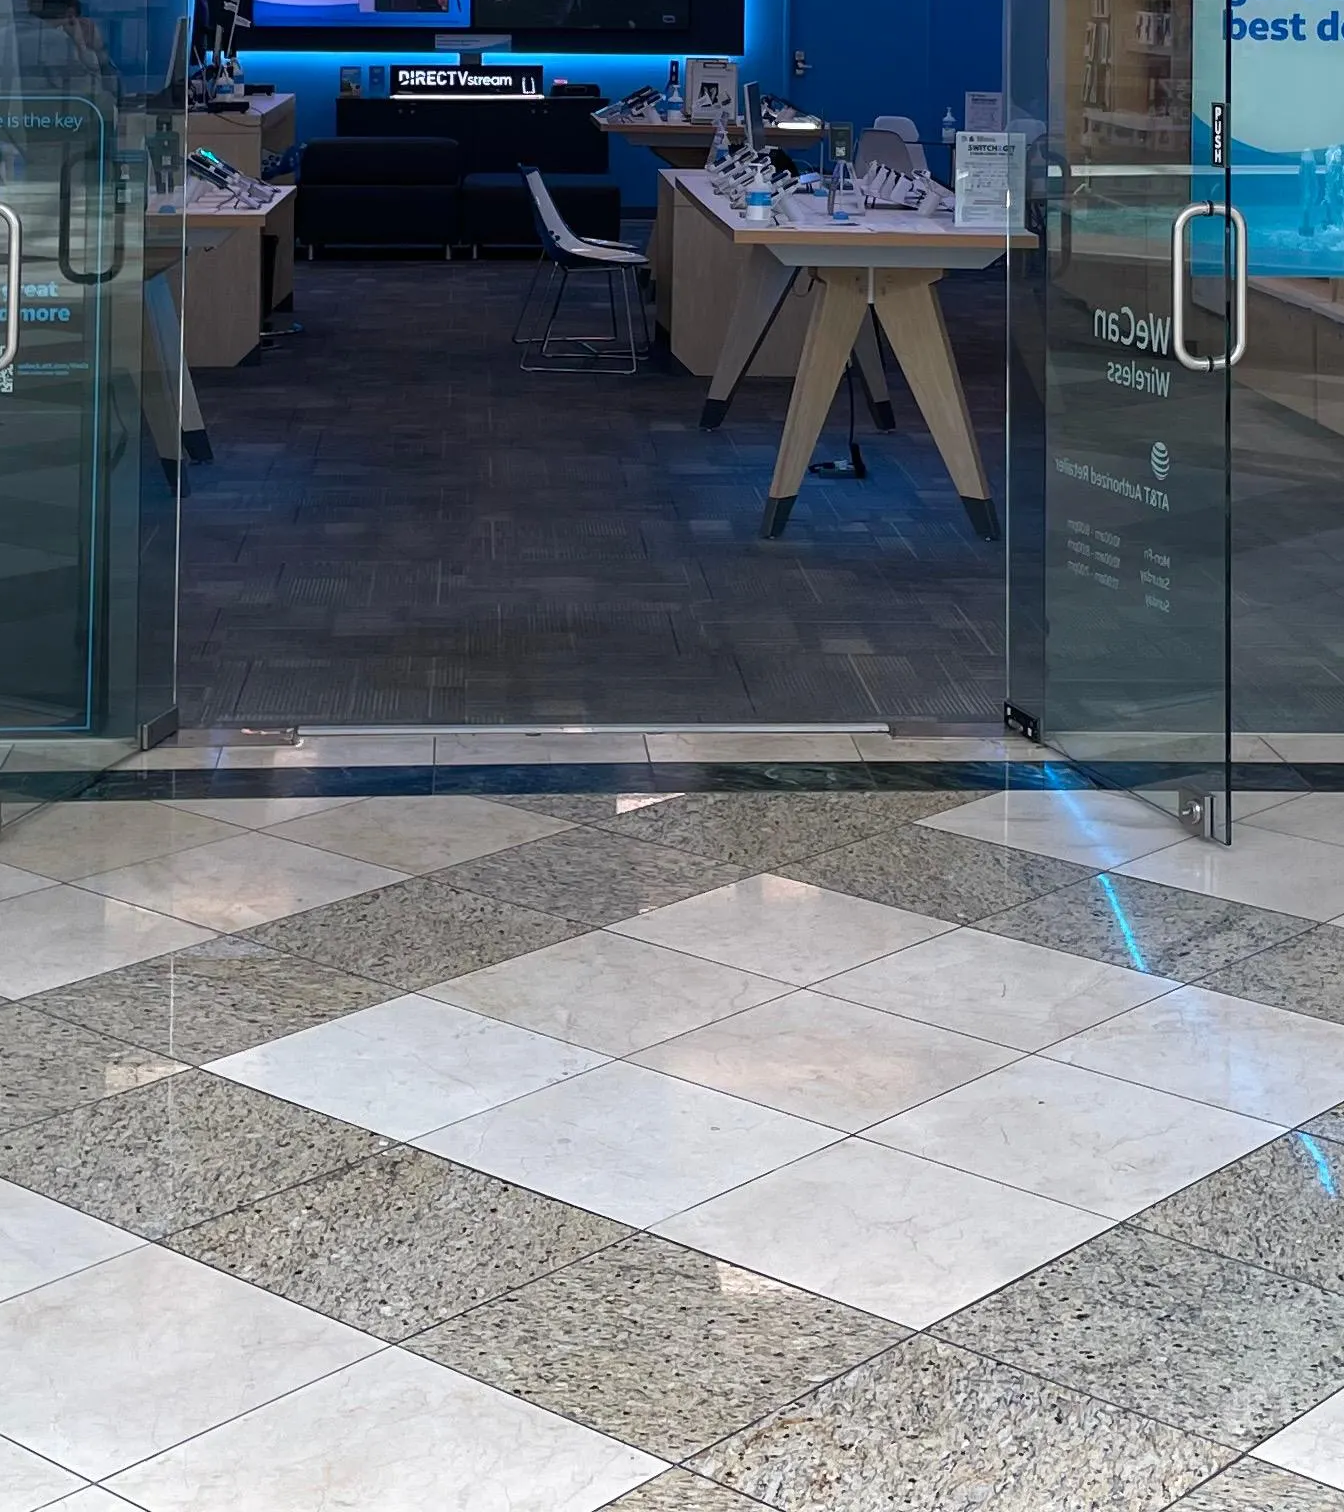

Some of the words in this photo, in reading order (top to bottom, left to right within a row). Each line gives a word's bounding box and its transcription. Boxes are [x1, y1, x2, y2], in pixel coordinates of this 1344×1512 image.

[1223, 9, 1308, 42] best
[398, 70, 469, 87] DIRECTV
[468, 74, 513, 87] stream
[7, 112, 19, 127] is
[23, 111, 51, 128] the
[55, 111, 83, 132] key
[1214, 106, 1223, 164] PUSH
[2, 280, 59, 302] eat
[19, 307, 71, 322] more
